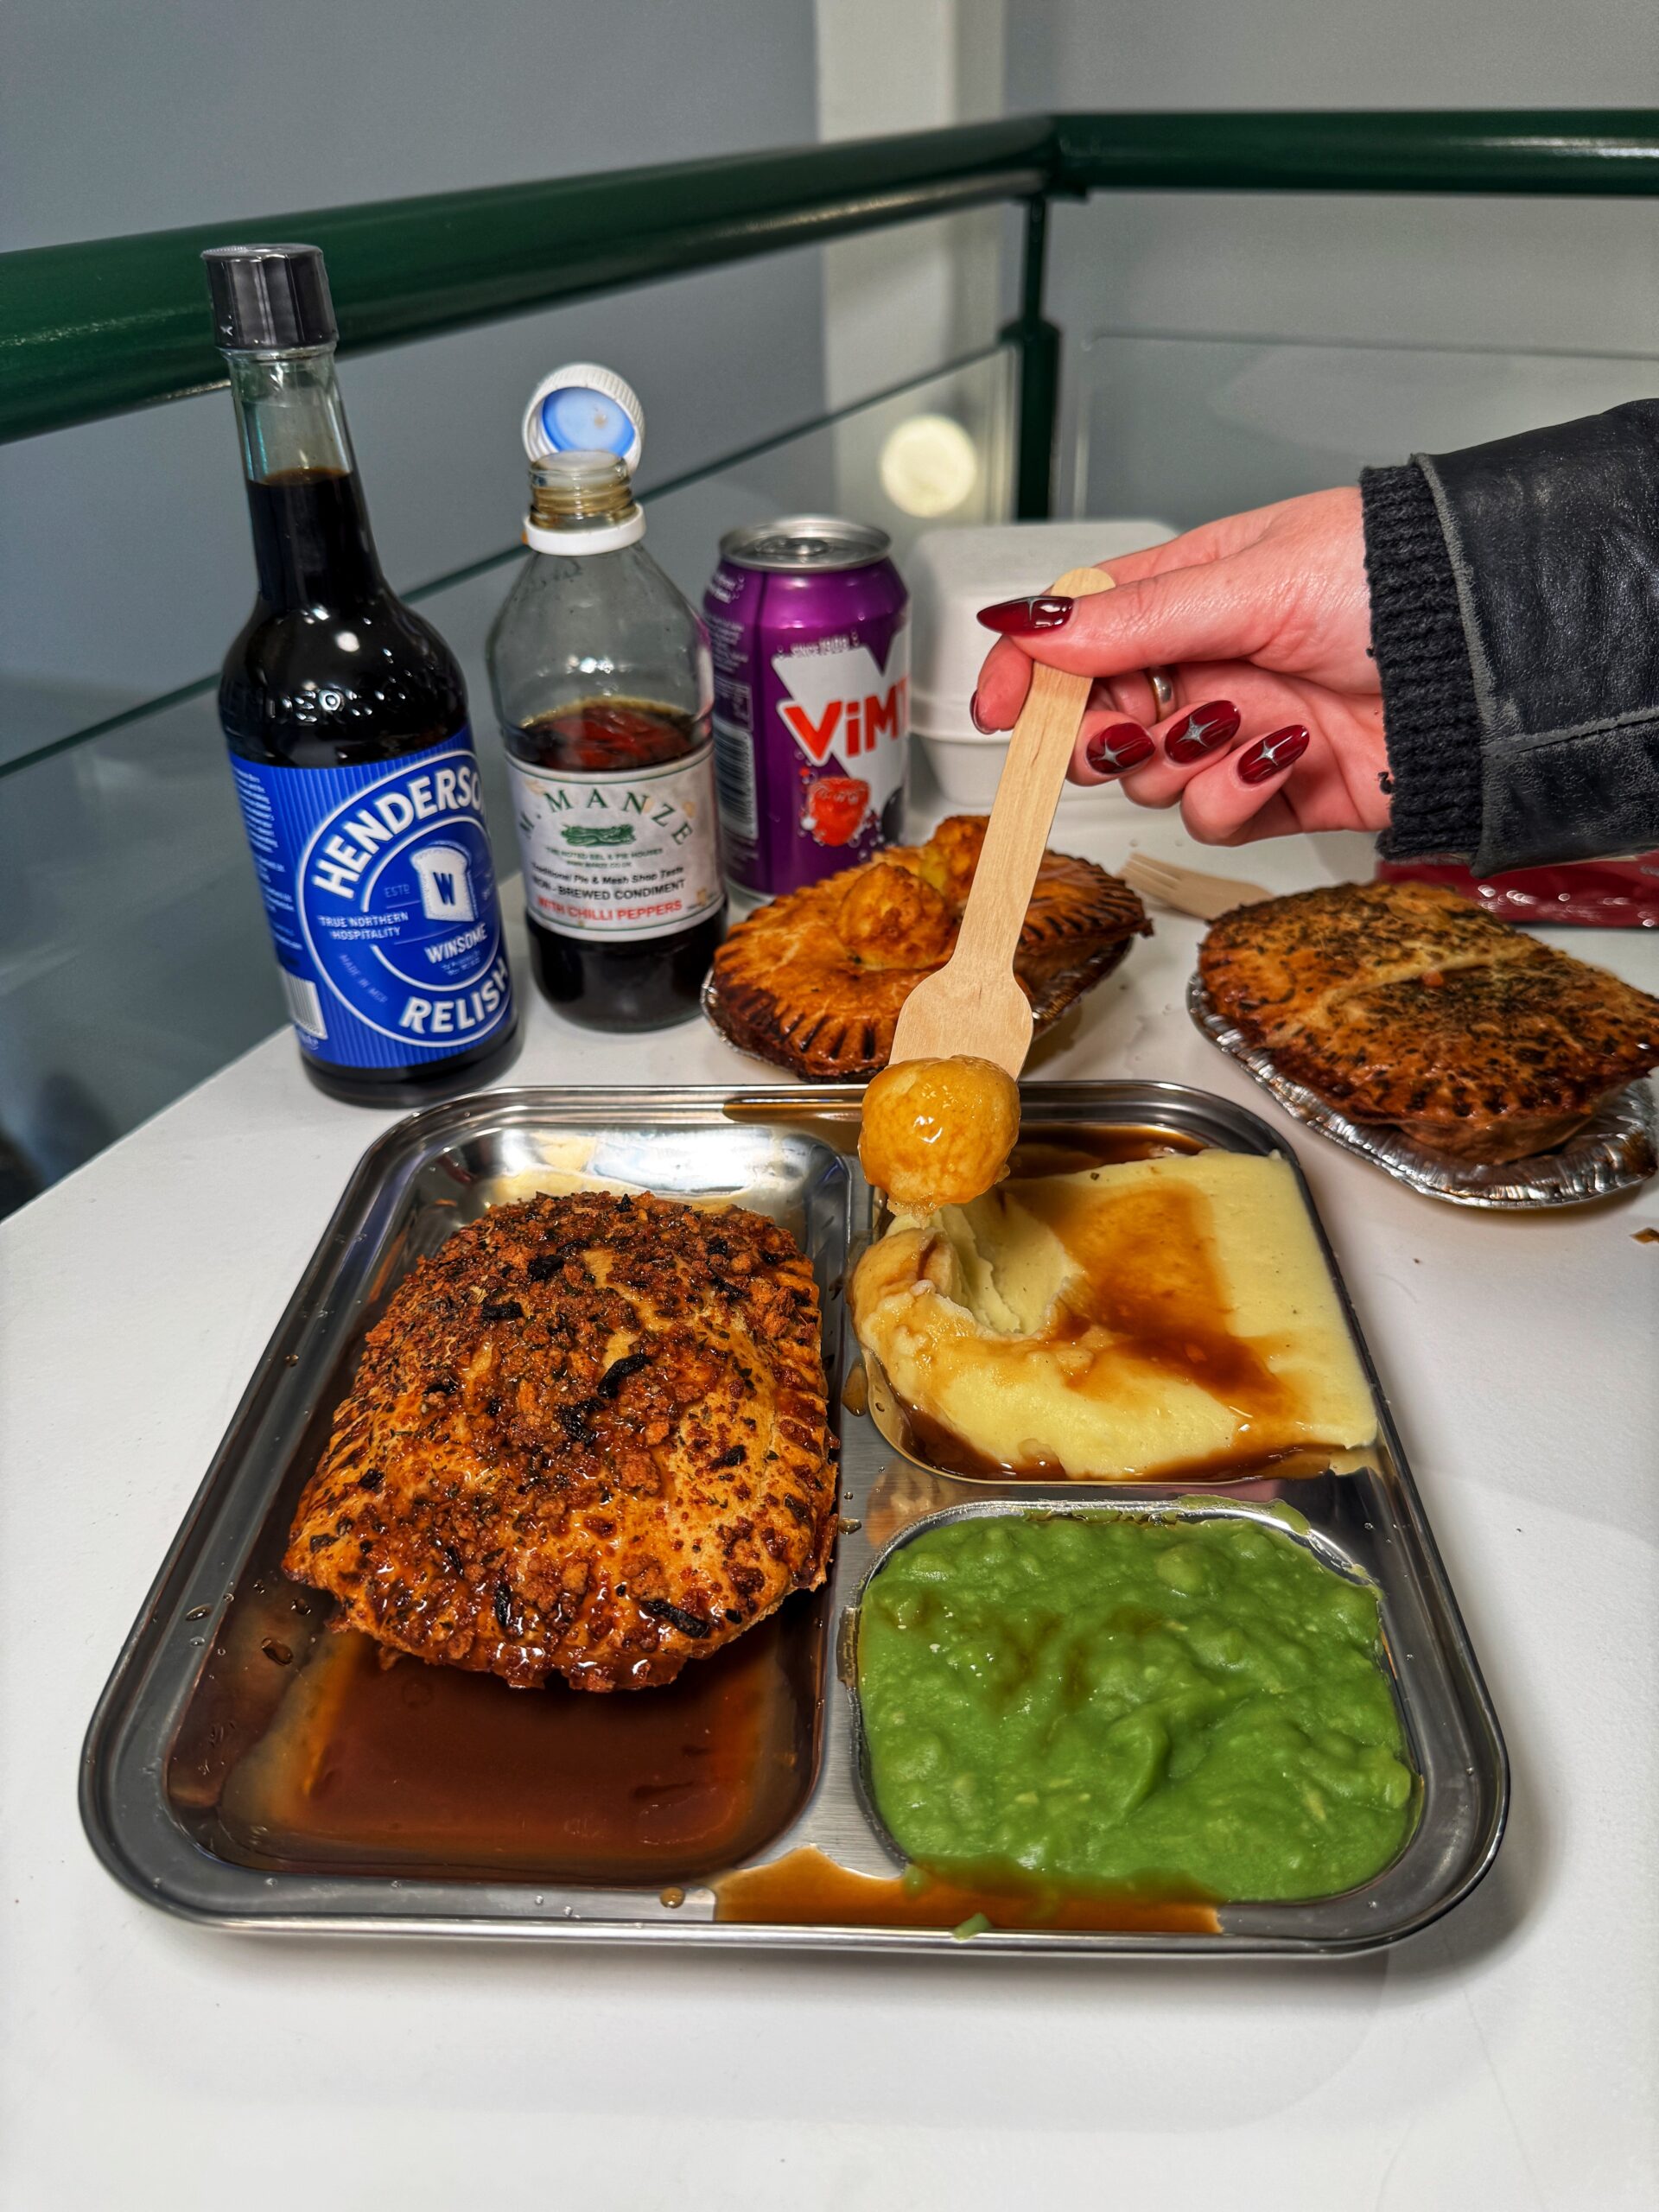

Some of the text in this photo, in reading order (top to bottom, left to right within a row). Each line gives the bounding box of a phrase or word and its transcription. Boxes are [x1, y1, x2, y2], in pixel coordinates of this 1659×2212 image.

[543, 788, 693, 846] MANZE
[312, 767, 485, 899] HENDERSO
[433, 871, 455, 906] W
[557, 887, 611, 901] BREWED
[614, 879, 686, 900] CONDIMENT
[574, 874, 589, 884] Pie
[592, 875, 601, 885] &
[632, 872, 658, 884] Shop
[317, 912, 410, 928] TRUE NORTHERN
[568, 905, 613, 921] CHILLI
[617, 899, 683, 921] PEPPERS
[329, 926, 401, 941] HOSPITALITY
[424, 924, 488, 964] WINSOME
[398, 963, 508, 1034] RELISH
